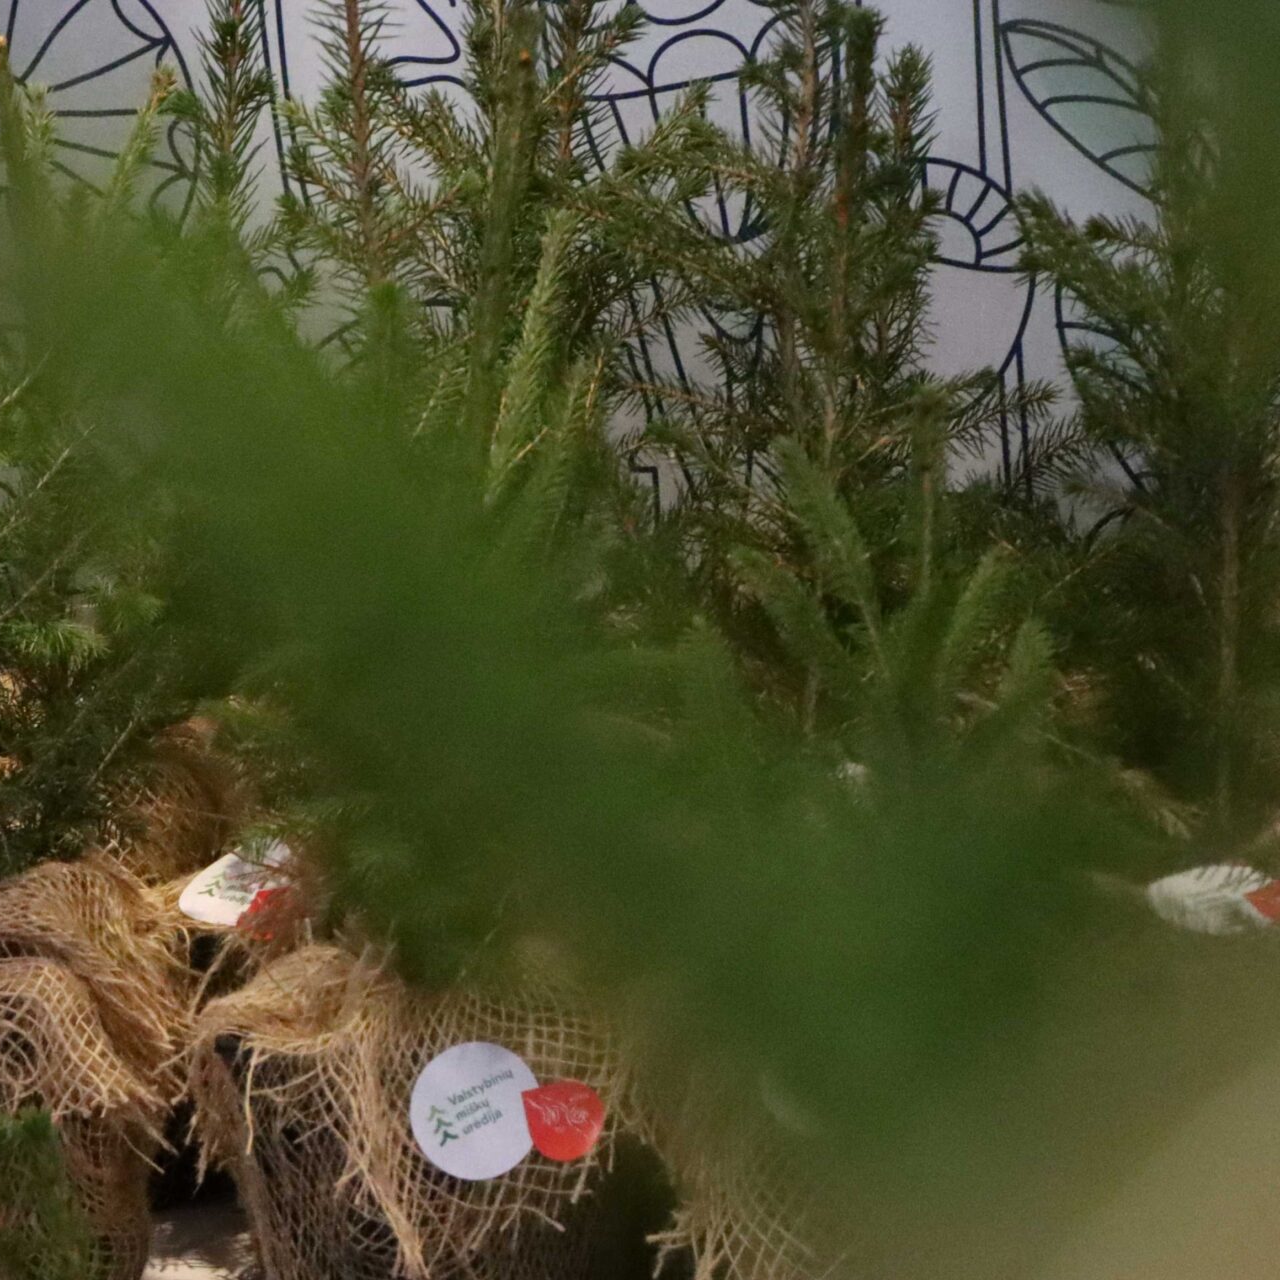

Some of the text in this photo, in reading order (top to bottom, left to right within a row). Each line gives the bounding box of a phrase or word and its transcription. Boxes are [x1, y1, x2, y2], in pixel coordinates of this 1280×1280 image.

[446, 1068, 515, 1106] Valstybinių
[455, 1098, 491, 1122] miškų
[461, 1108, 504, 1136] urėdija
